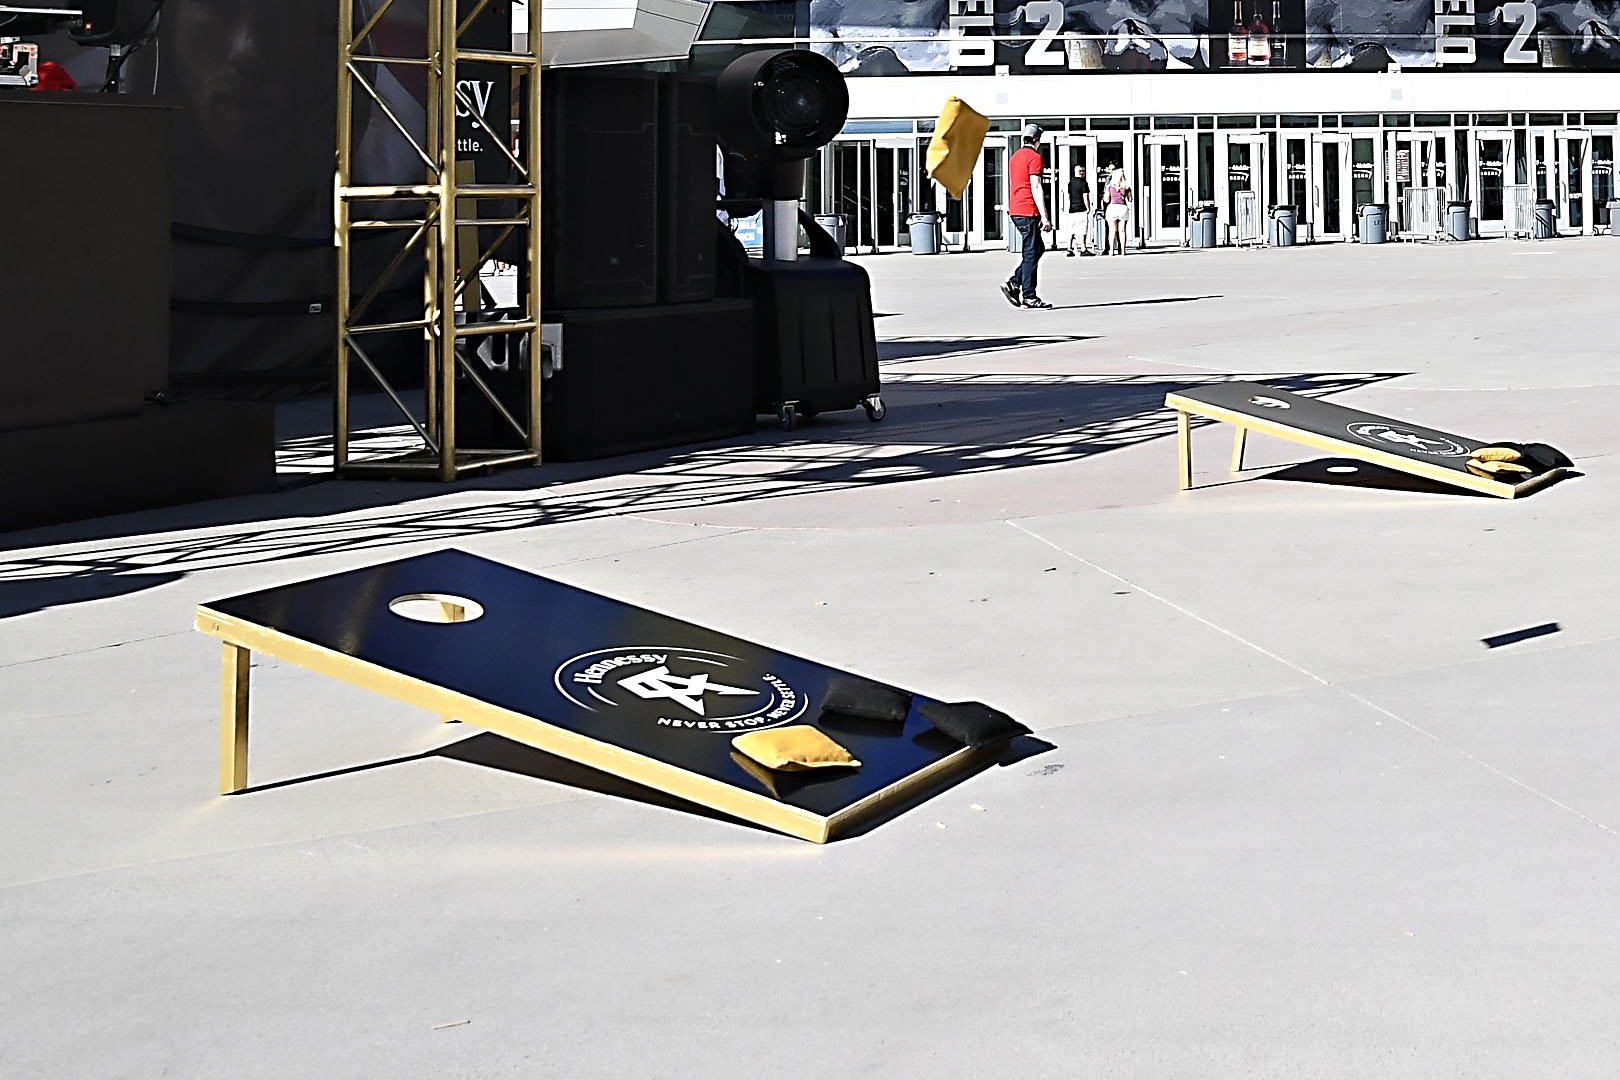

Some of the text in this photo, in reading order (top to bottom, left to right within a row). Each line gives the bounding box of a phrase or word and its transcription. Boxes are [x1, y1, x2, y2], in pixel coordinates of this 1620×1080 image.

[1024, 0, 1065, 66] 2
[1502, 1, 1538, 64] 2
[457, 138, 483, 152] ttle.
[573, 653, 668, 685] Hennessy
[656, 717, 721, 729] NEVER
[724, 716, 771, 728] STOP.
